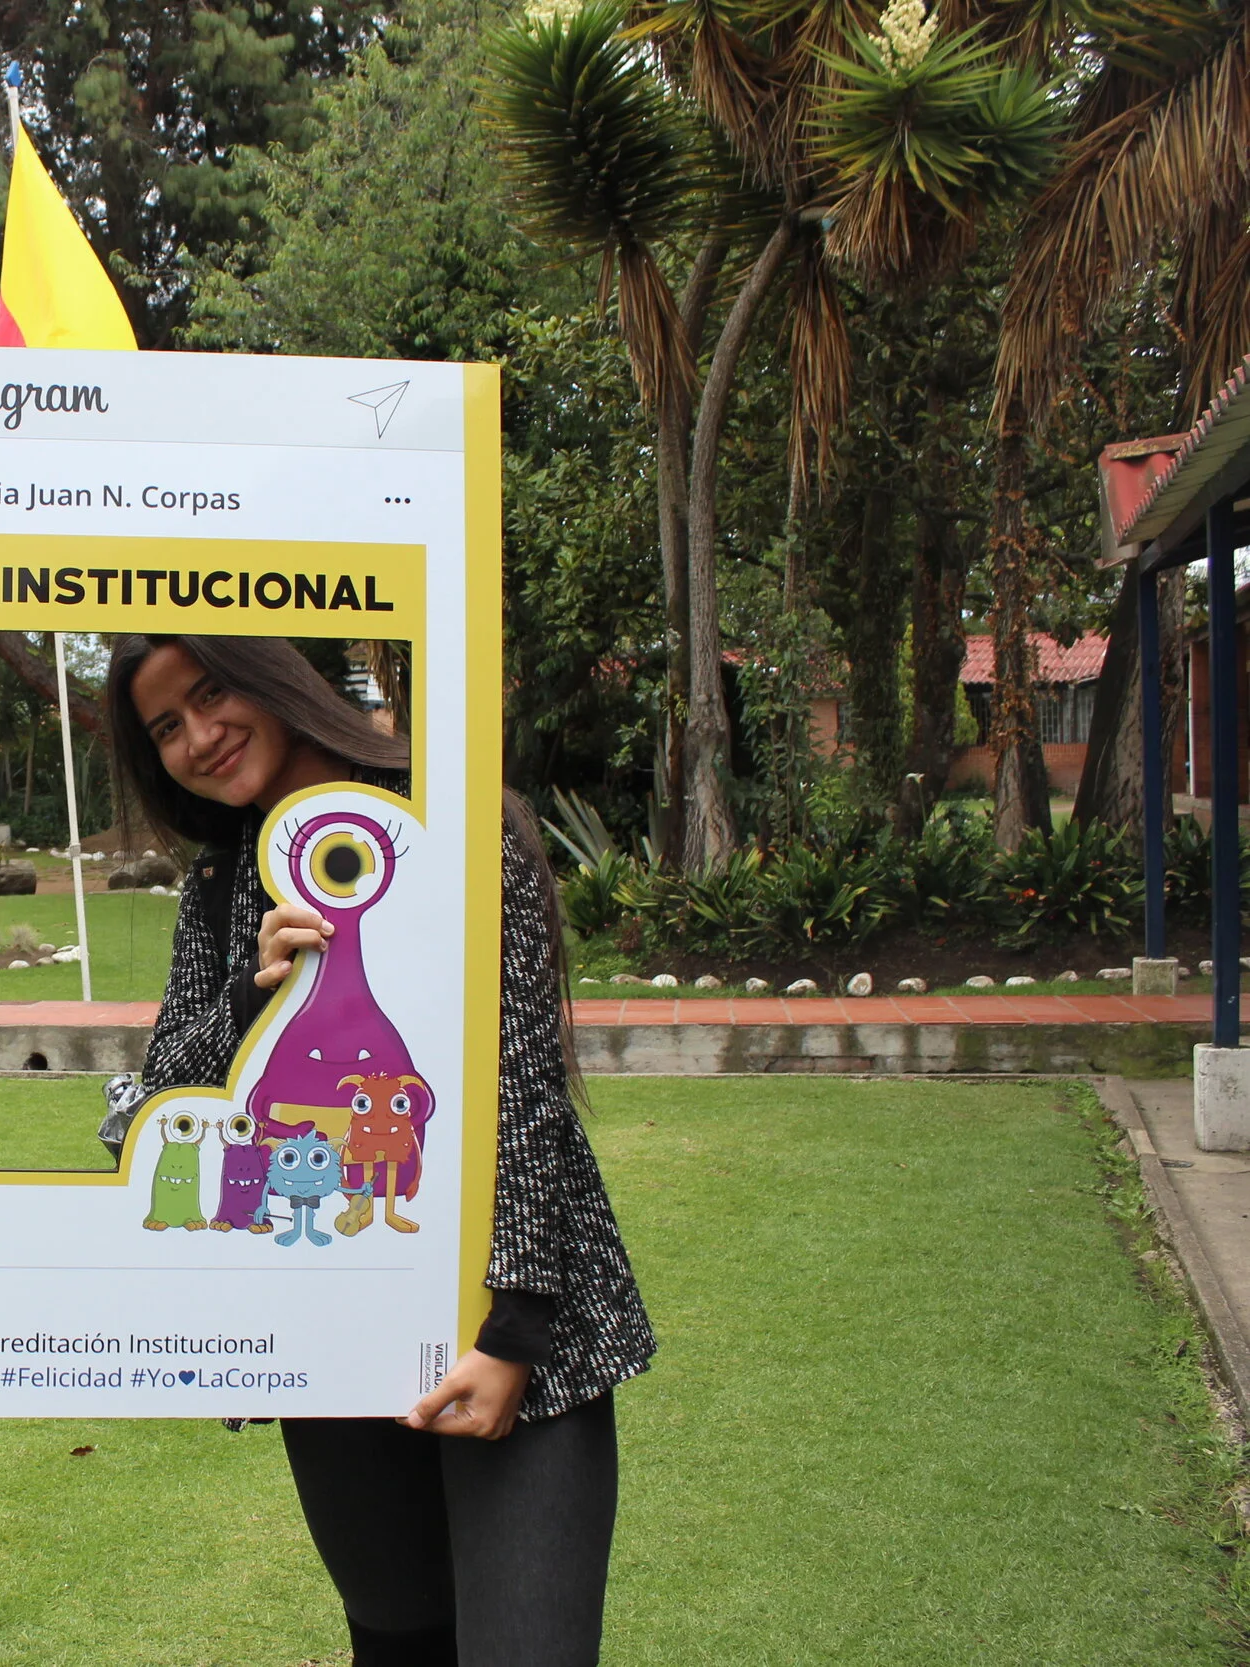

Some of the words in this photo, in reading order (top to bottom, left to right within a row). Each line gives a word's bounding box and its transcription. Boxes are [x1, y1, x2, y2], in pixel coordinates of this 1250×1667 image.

[26, 483, 92, 511] Juan
[103, 484, 132, 508] N.
[141, 485, 241, 517] Corpas
[2, 566, 394, 612] INSTITUCIONAL
[130, 1333, 274, 1354] Institucional
[0, 1366, 122, 1388] #Felicidad
[434, 1343, 444, 1389] VIGILAD
